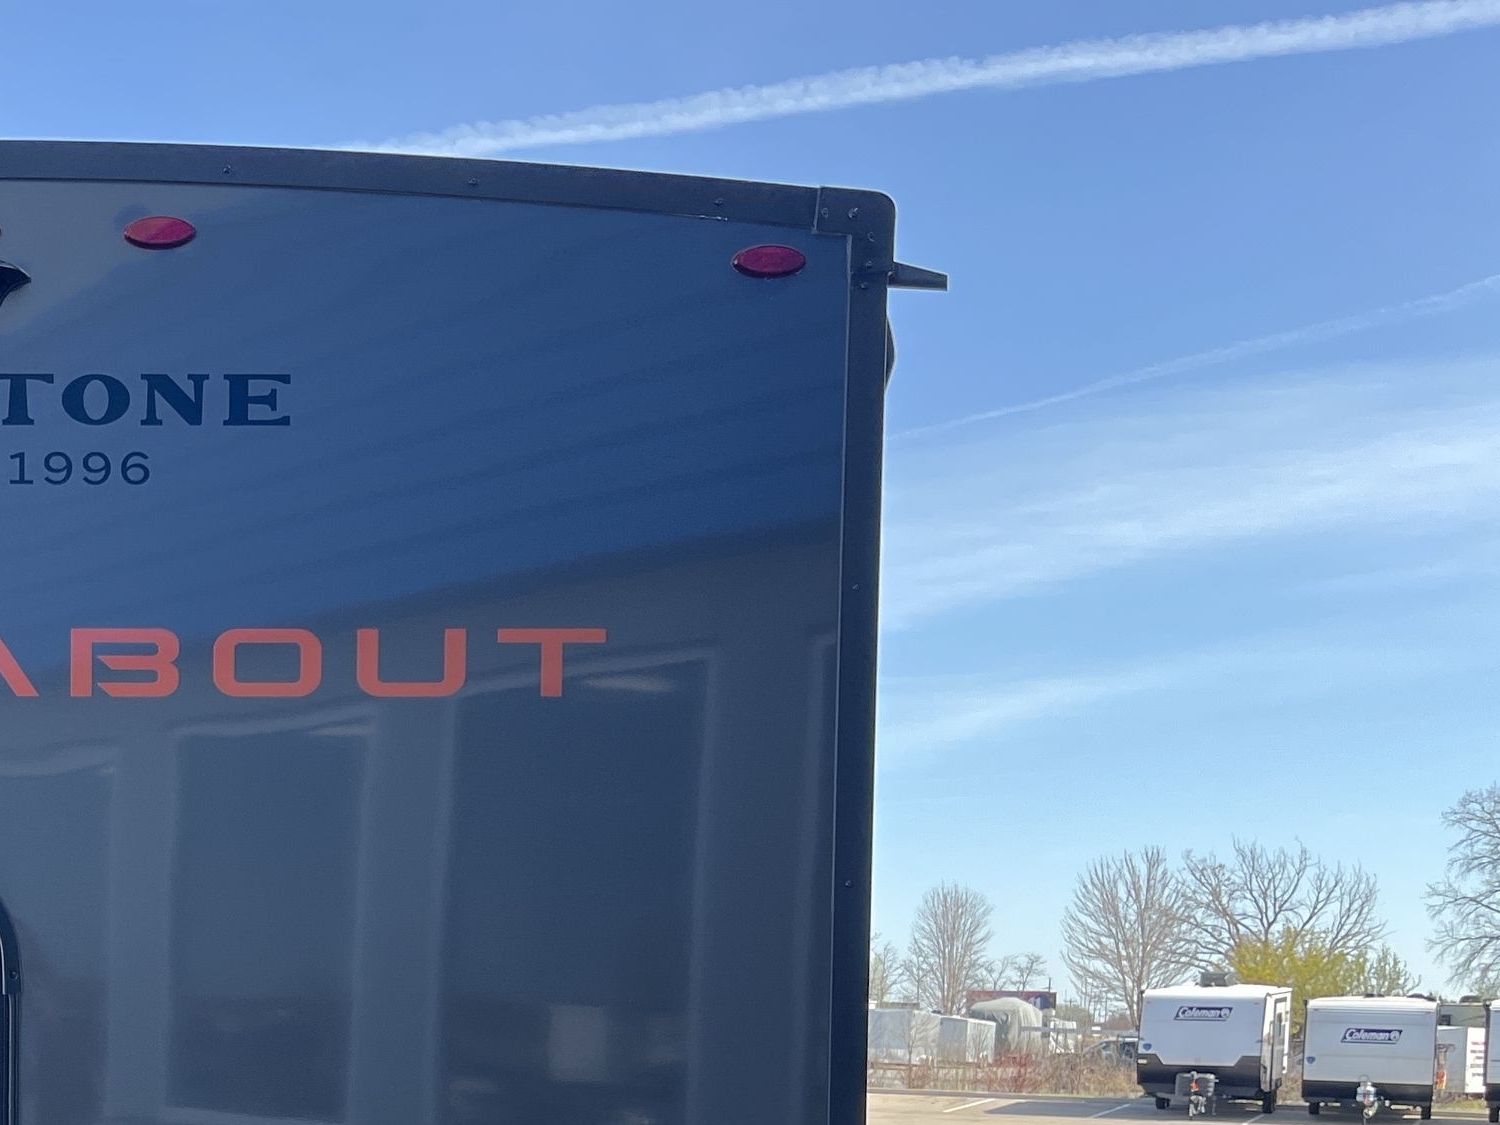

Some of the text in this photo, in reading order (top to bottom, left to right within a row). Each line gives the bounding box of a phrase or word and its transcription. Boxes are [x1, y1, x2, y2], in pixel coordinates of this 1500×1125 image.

[8, 450, 152, 487] 1996
[1178, 1006, 1221, 1018] Coleman
[1345, 1028, 1389, 1041] Coleman
